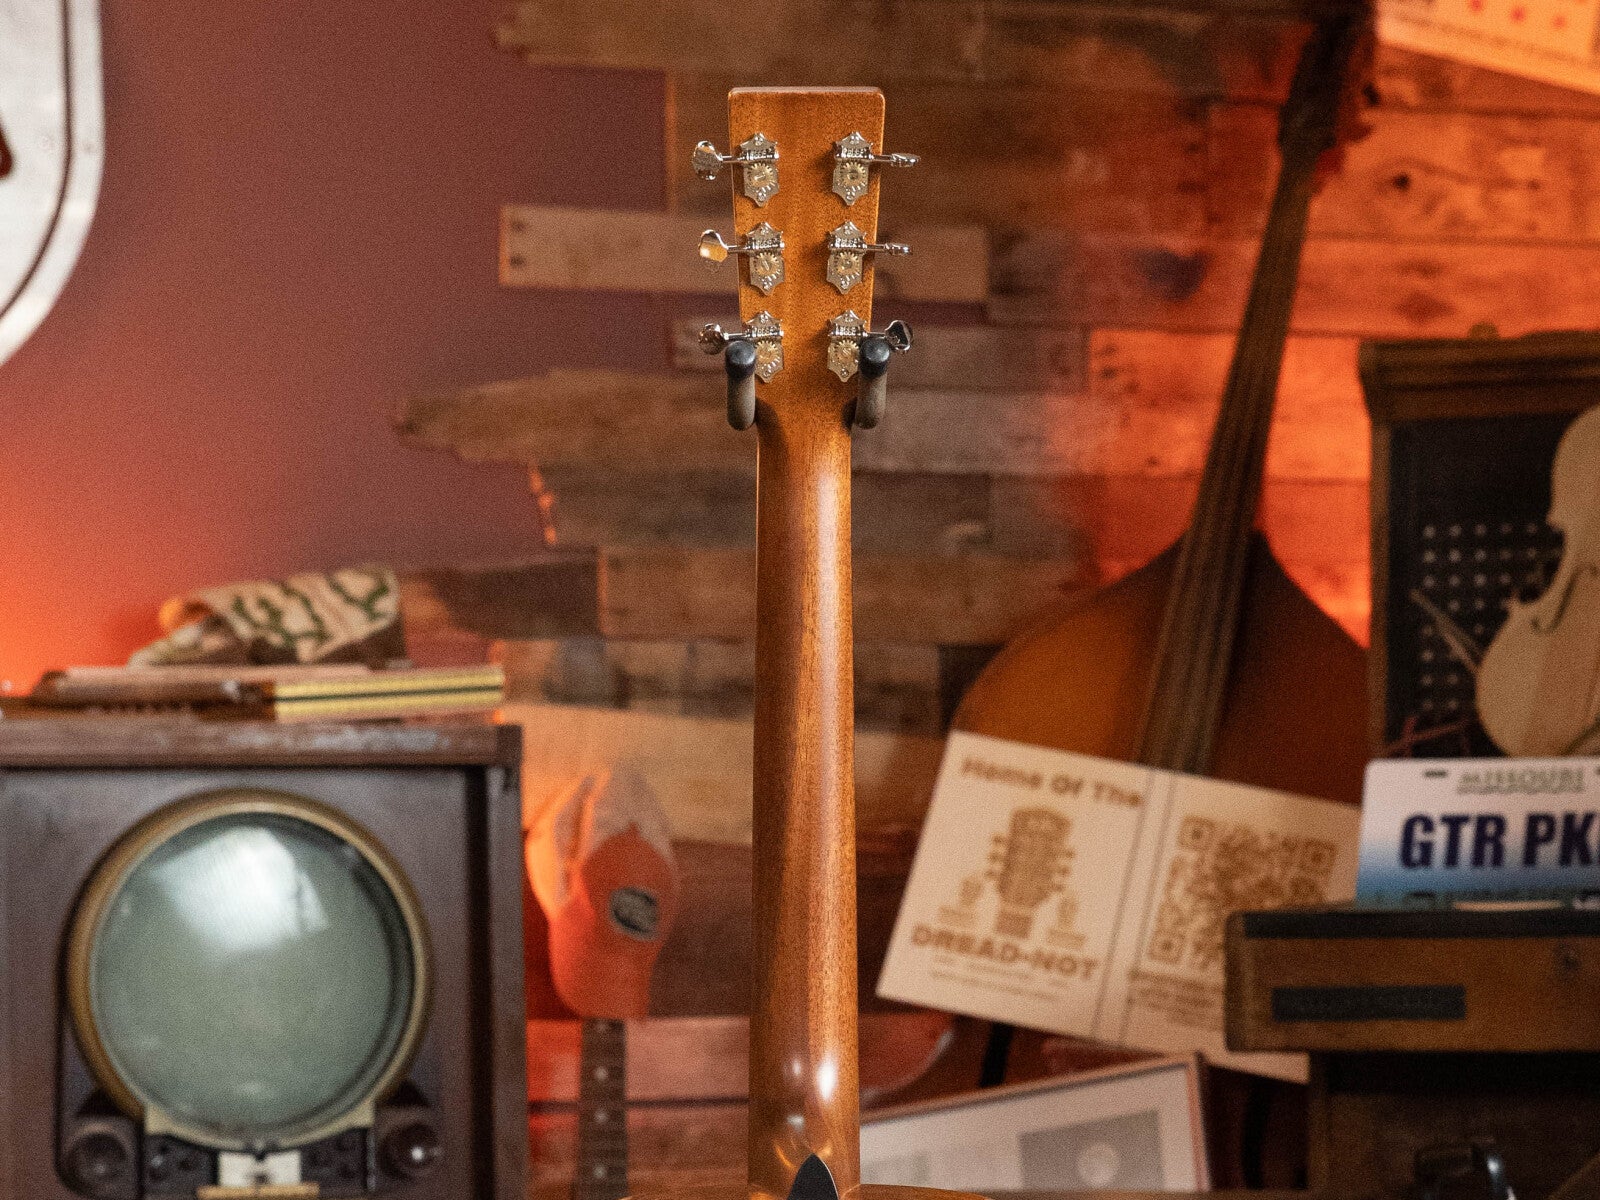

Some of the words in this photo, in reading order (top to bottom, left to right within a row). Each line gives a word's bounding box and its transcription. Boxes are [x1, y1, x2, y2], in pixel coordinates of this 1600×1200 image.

[960, 756, 1043, 788] Home
[1051, 773, 1085, 797] Of
[1093, 782, 1144, 807] The
[1400, 813, 1506, 869] GTR
[1523, 811, 1600, 867] PK
[910, 924, 1098, 981] DREAD-NOT
